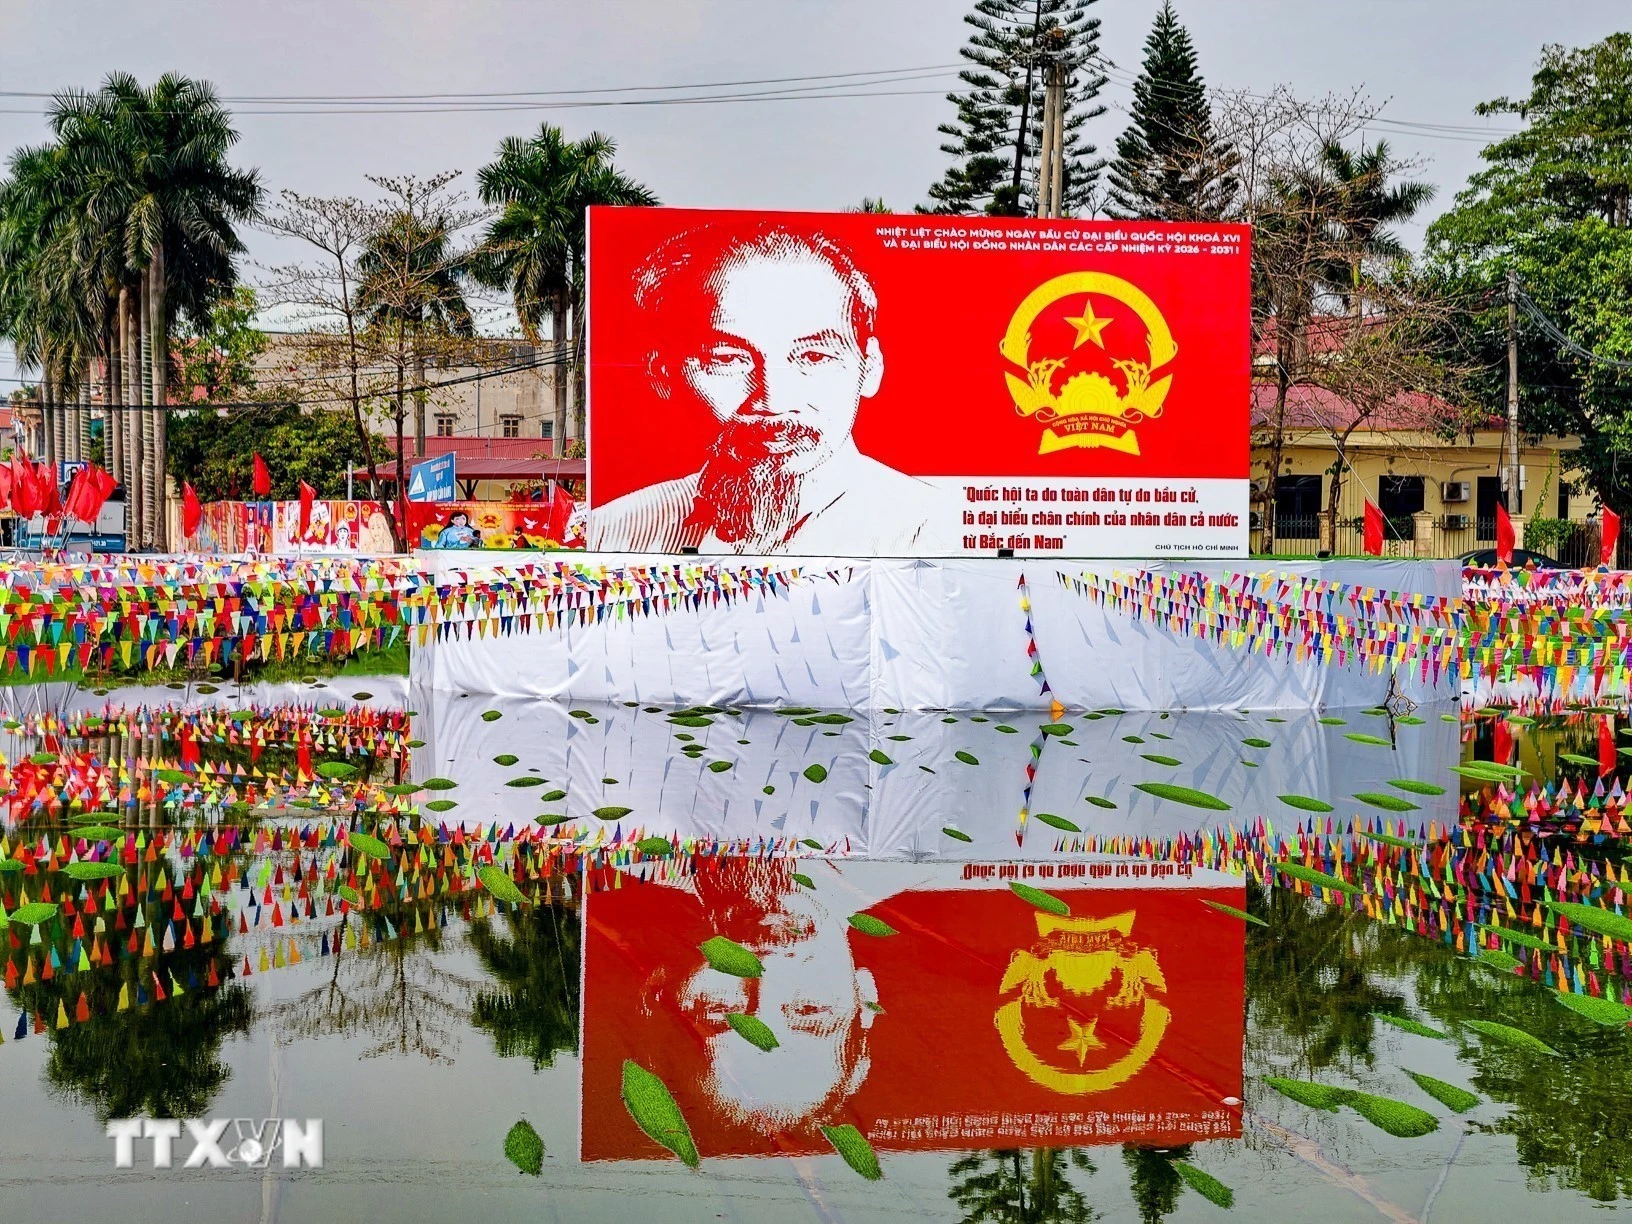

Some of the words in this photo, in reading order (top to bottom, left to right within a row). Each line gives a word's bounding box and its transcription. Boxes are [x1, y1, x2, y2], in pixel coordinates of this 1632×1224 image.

[876, 226, 907, 238] NHIỆT
[910, 227, 932, 239] LIỆT
[934, 227, 966, 238] CHÀO
[969, 227, 1003, 239] MỪNG
[1006, 228, 1036, 240] NGÀY
[1082, 231, 1102, 242] ĐẠI
[1104, 230, 1128, 241] BIỂU
[1130, 231, 1163, 242] QUỐC
[1167, 231, 1186, 243] HỘI
[1223, 234, 1240, 243] XVI
[883, 239, 898, 248] VÀ
[901, 241, 920, 250] ĐẠI
[923, 238, 947, 249] BIỂU
[950, 239, 970, 251] HỘI
[973, 238, 1007, 250] ĐỒNG
[1010, 240, 1041, 251] NHÂN
[1043, 241, 1066, 252] DÂN
[1069, 242, 1093, 252] CÁC
[1095, 242, 1118, 252] CẤP
[1121, 244, 1154, 255] NHIỆM
[1174, 245, 1200, 254] 2026
[1210, 245, 1233, 254] 2031
[1064, 421, 1088, 432] VIỆT
[1091, 422, 1116, 433] NAM
[1002, 486, 1022, 505] hội
[1026, 488, 1038, 501] ta
[1042, 487, 1057, 501] do
[1061, 487, 1089, 502] toàn
[1092, 488, 1116, 502] dân
[1119, 488, 1132, 506] tự
[1136, 488, 1151, 502] do
[1154, 486, 1176, 502] bầu
[1180, 486, 1199, 504] cử,
[963, 510, 974, 525] là
[978, 510, 998, 528] đại
[1001, 508, 1028, 525] biểu
[1032, 511, 1062, 526] chân
[1066, 511, 1100, 526] chính
[1104, 510, 1126, 526] của
[1130, 512, 1160, 526] nhân
[1164, 512, 1186, 526] dân
[1190, 510, 1204, 526] cả
[1208, 512, 1238, 527] nước
[963, 534, 976, 549] từ
[980, 532, 1004, 549] Bắc
[1008, 532, 1030, 549] đến
